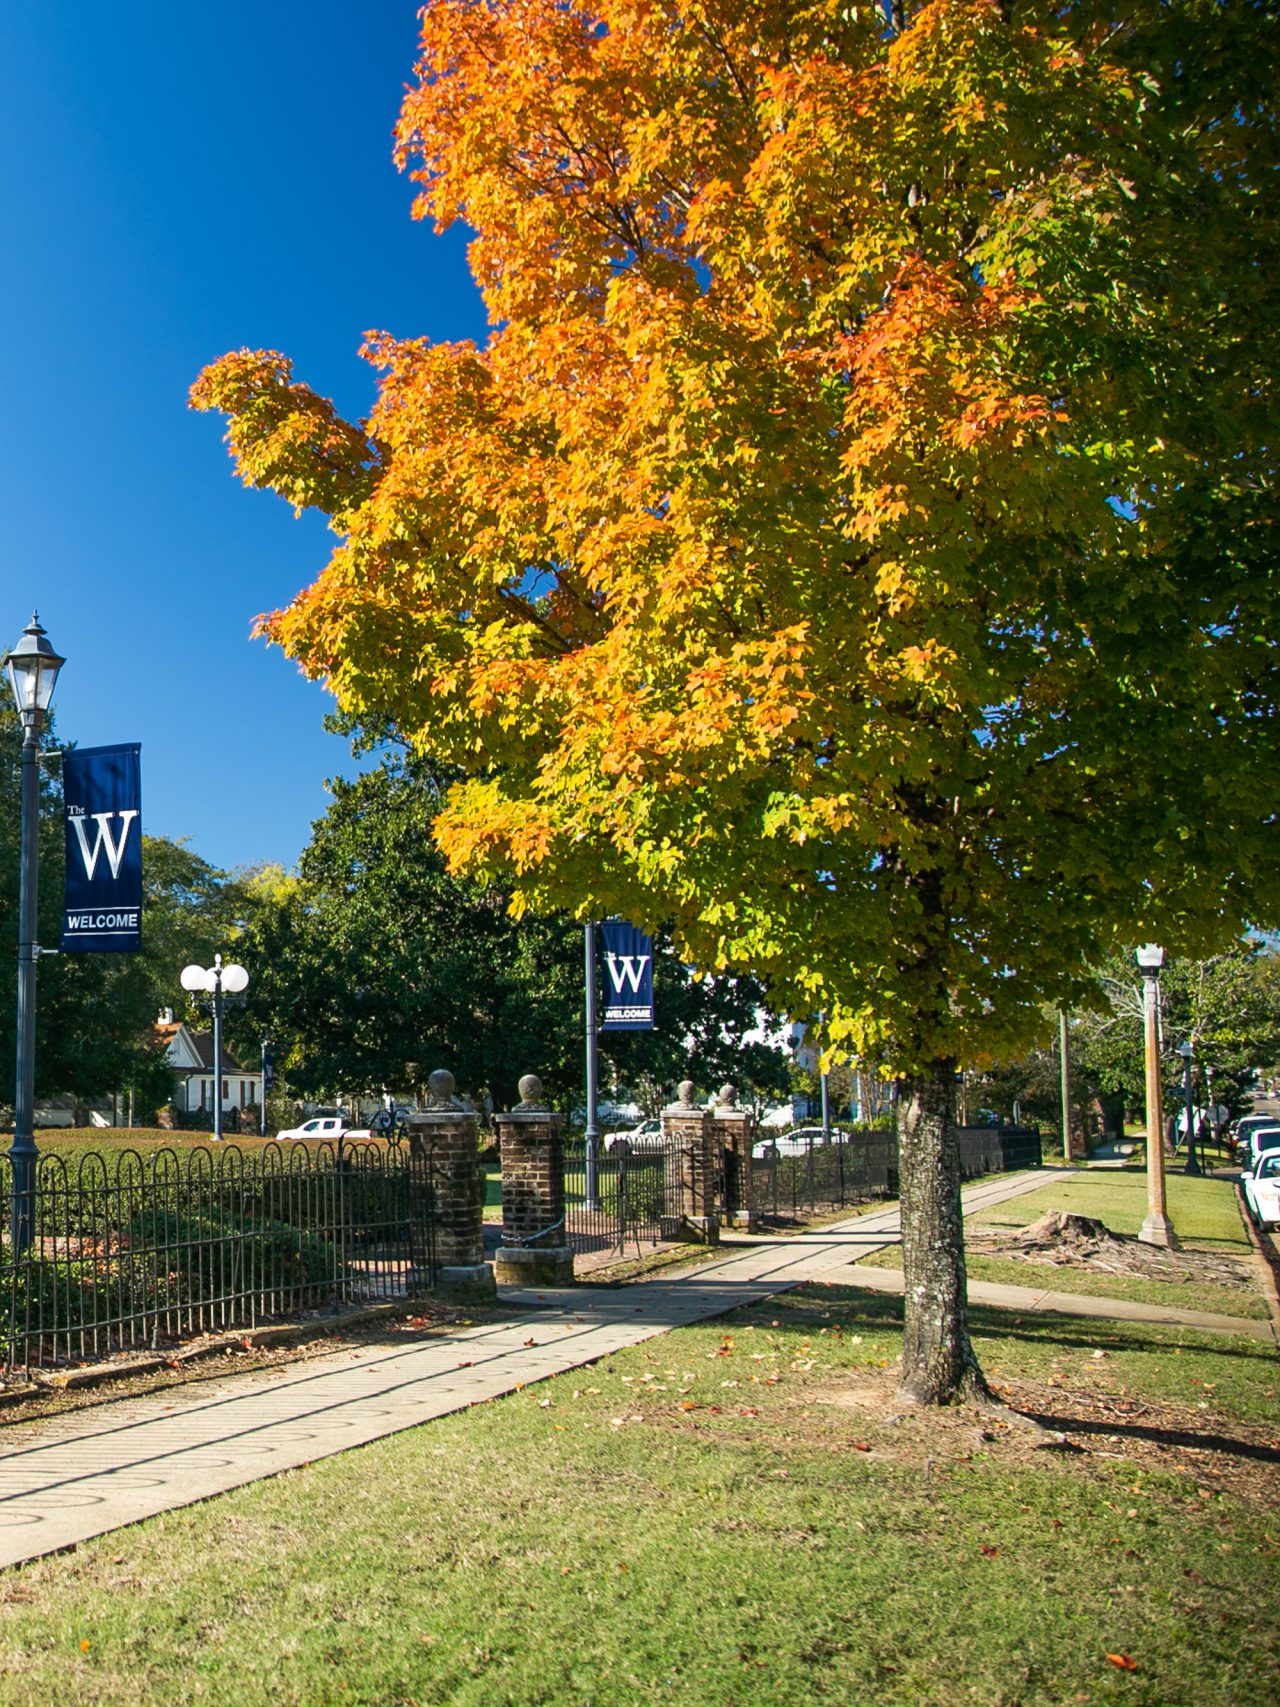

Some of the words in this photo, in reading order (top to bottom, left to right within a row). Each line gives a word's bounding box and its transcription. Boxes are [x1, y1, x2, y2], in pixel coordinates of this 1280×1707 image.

[67, 805, 85, 814] The
[68, 810, 139, 881] W
[68, 914, 138, 929] WELCOME
[603, 955, 650, 993] W
[605, 1009, 651, 1019] WELCOME
